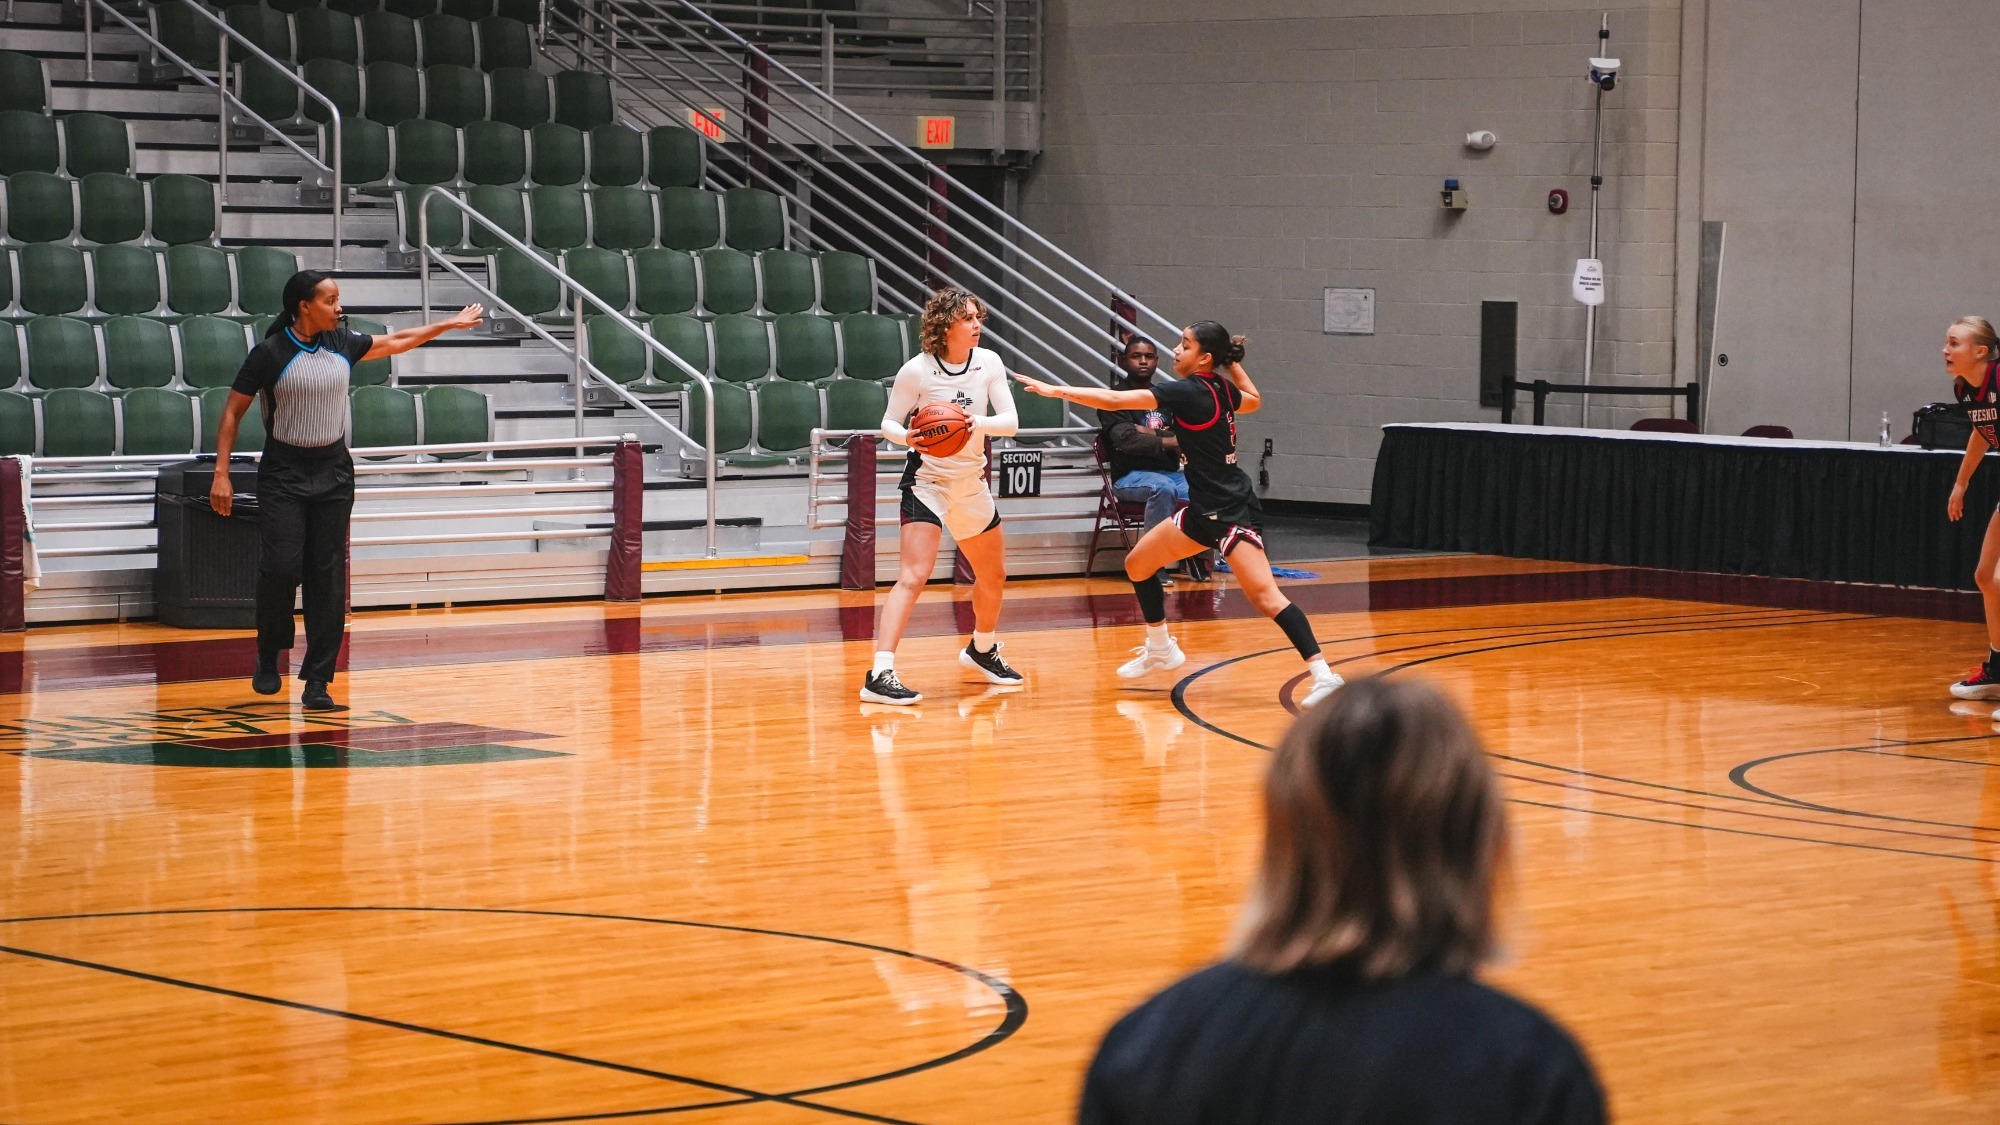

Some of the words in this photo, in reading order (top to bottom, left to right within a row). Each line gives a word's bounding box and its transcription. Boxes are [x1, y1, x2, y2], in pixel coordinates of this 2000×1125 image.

[926, 119, 951, 144] EXIT
[1002, 452, 1041, 464] SECTION
[1007, 466, 1035, 494] 101
